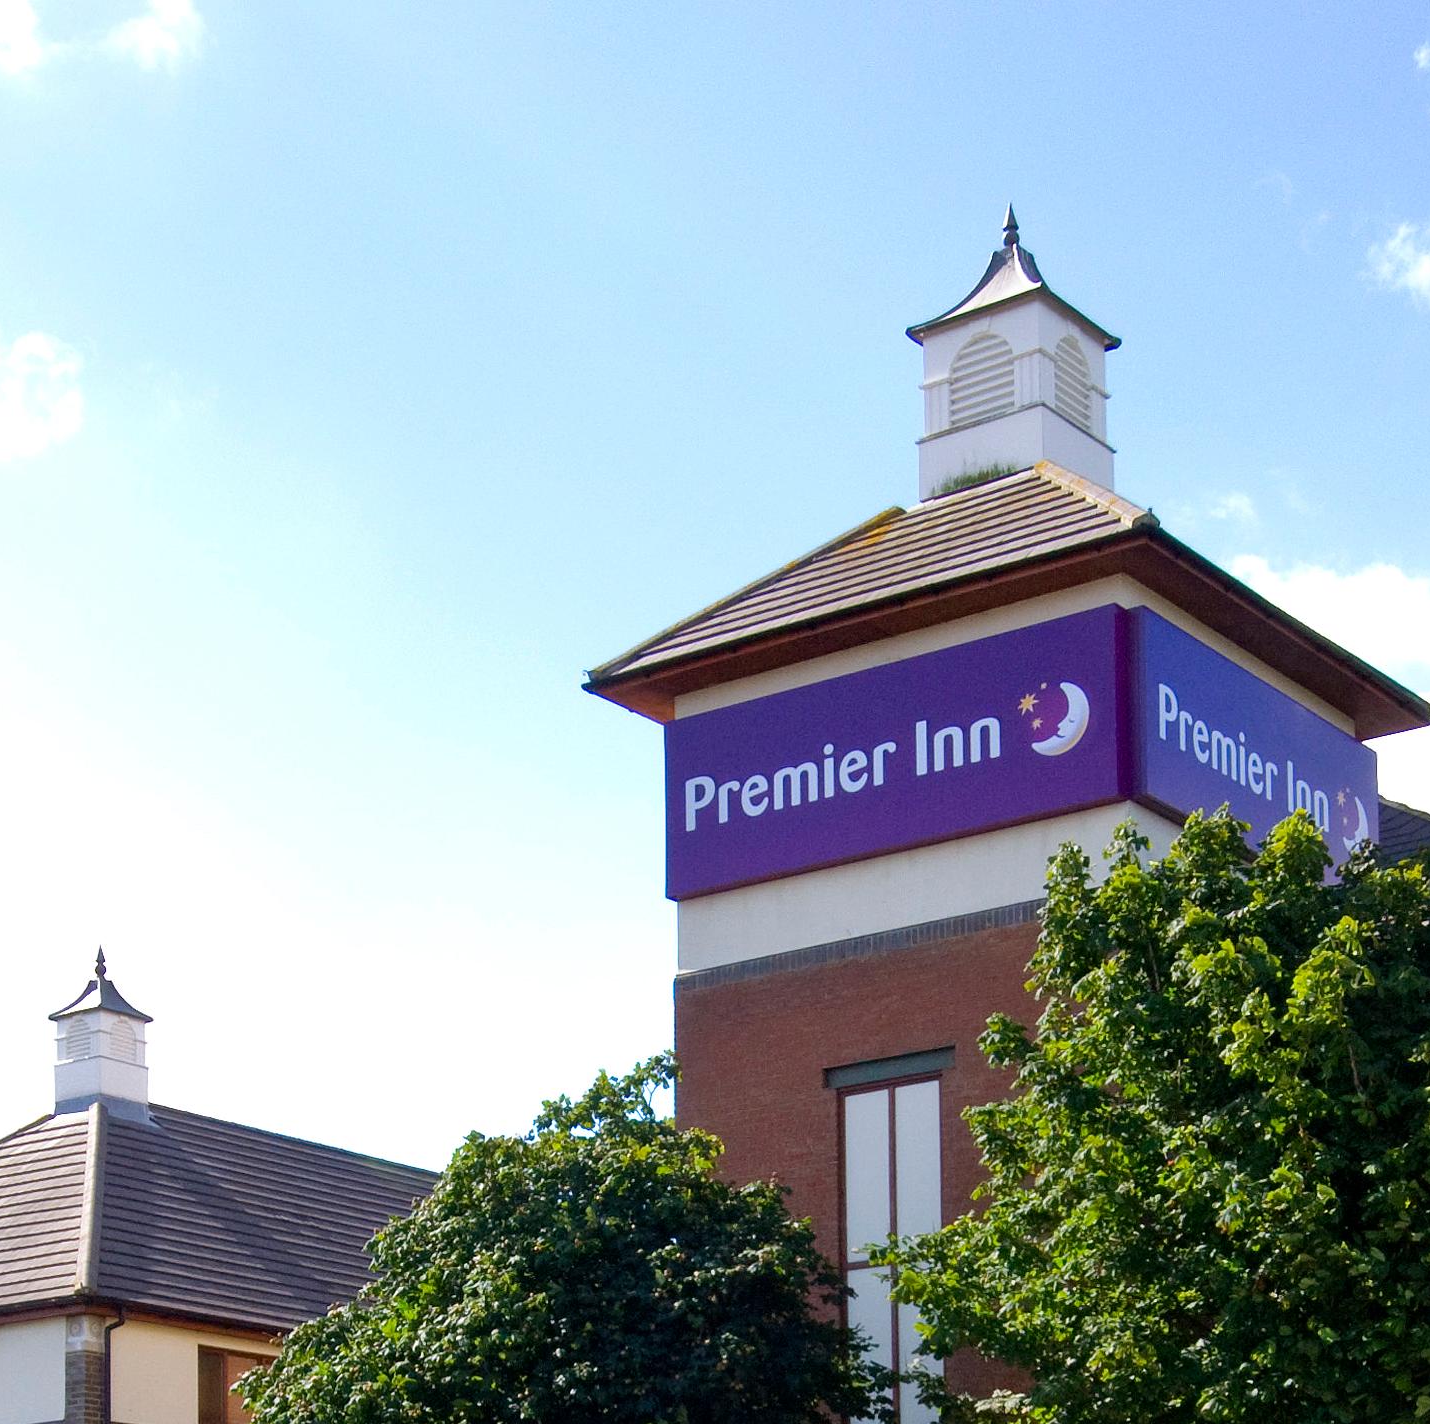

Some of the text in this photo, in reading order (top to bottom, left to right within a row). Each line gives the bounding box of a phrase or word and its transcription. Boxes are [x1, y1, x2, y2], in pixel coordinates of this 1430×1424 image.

[684, 716, 1001, 832] Premier Inn
[1159, 682, 1330, 833] Premier Inn
